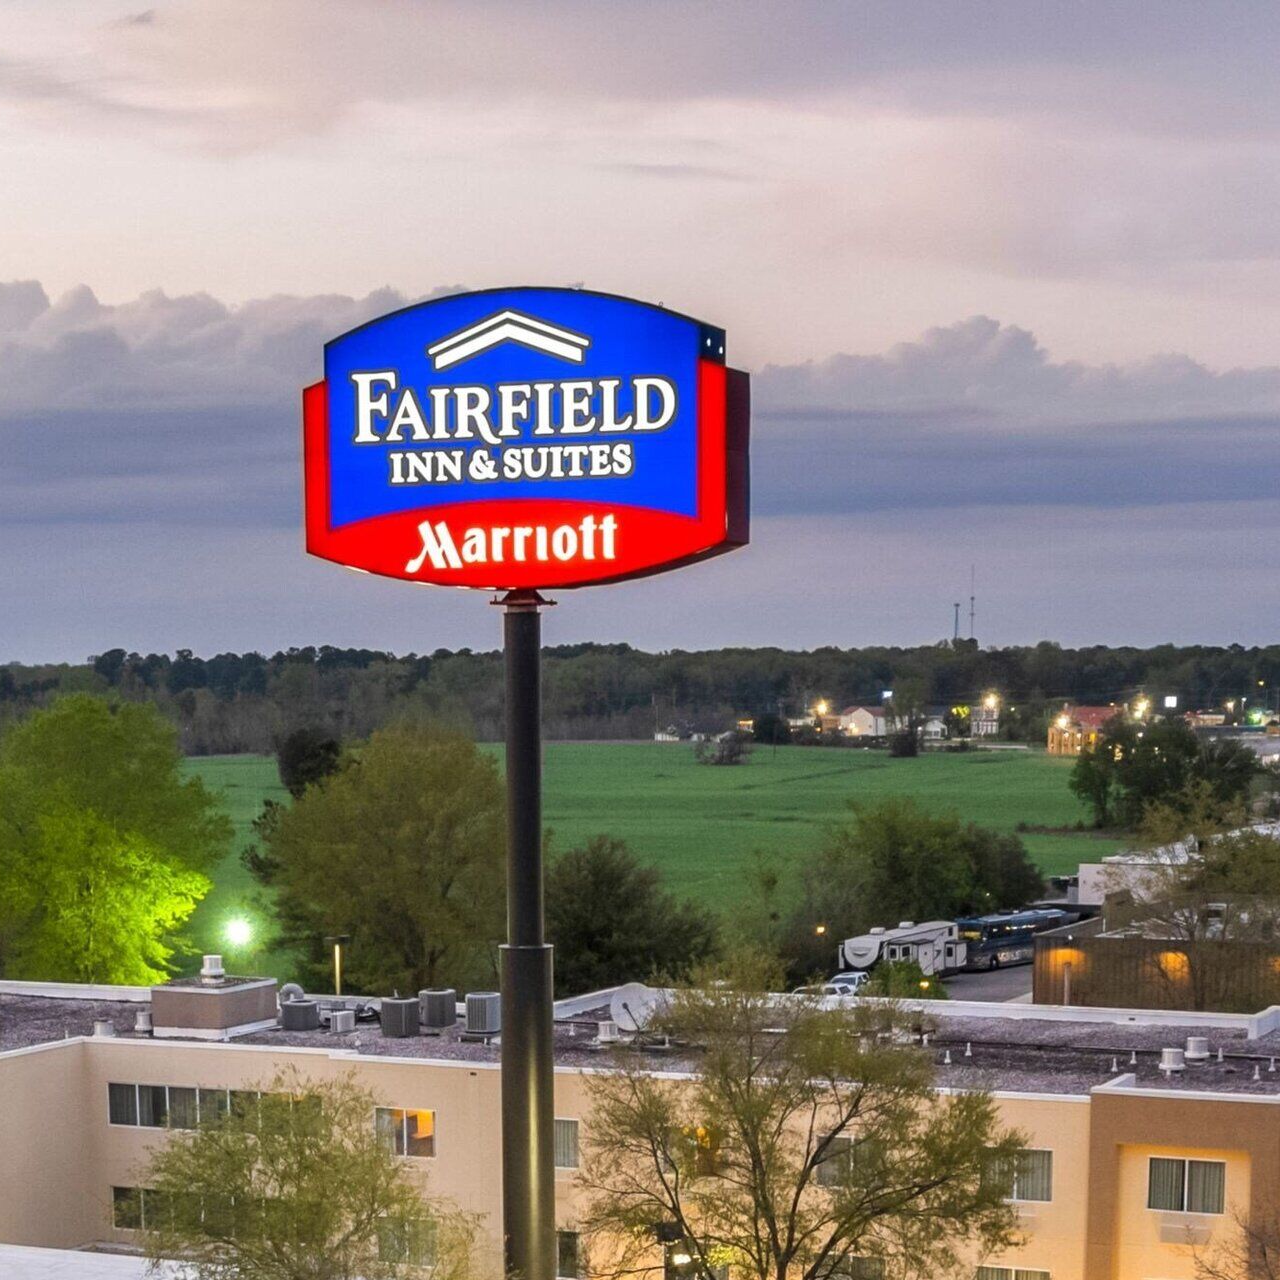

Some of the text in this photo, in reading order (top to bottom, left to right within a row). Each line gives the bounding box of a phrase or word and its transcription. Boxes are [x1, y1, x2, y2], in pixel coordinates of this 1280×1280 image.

[350, 371, 676, 444] FAIRFIELD
[389, 443, 633, 484] INN & SUITES
[405, 514, 618, 574] Marriott
